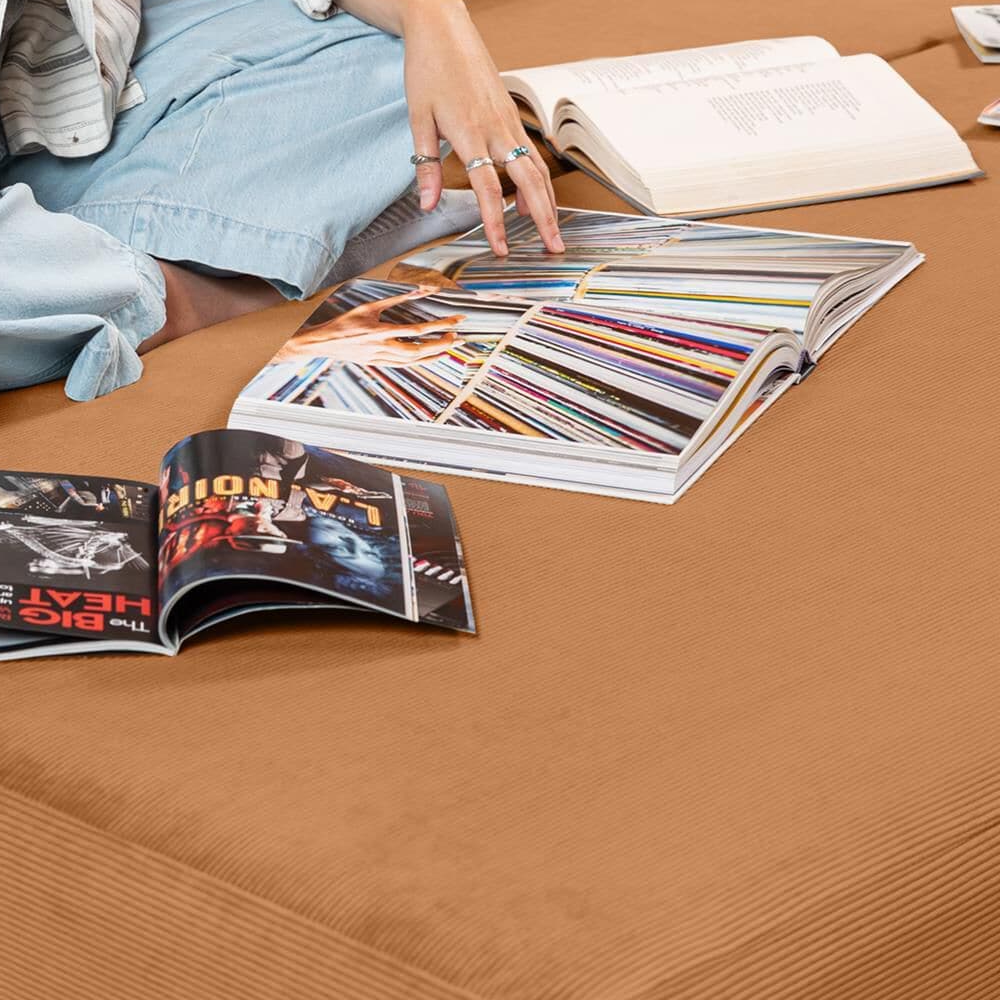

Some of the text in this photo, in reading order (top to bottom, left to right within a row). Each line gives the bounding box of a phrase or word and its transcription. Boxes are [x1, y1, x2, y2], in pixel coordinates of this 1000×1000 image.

[291, 484, 382, 527] L.A.
[18, 588, 151, 616] HEAT
[18, 607, 150, 633] The BIG
